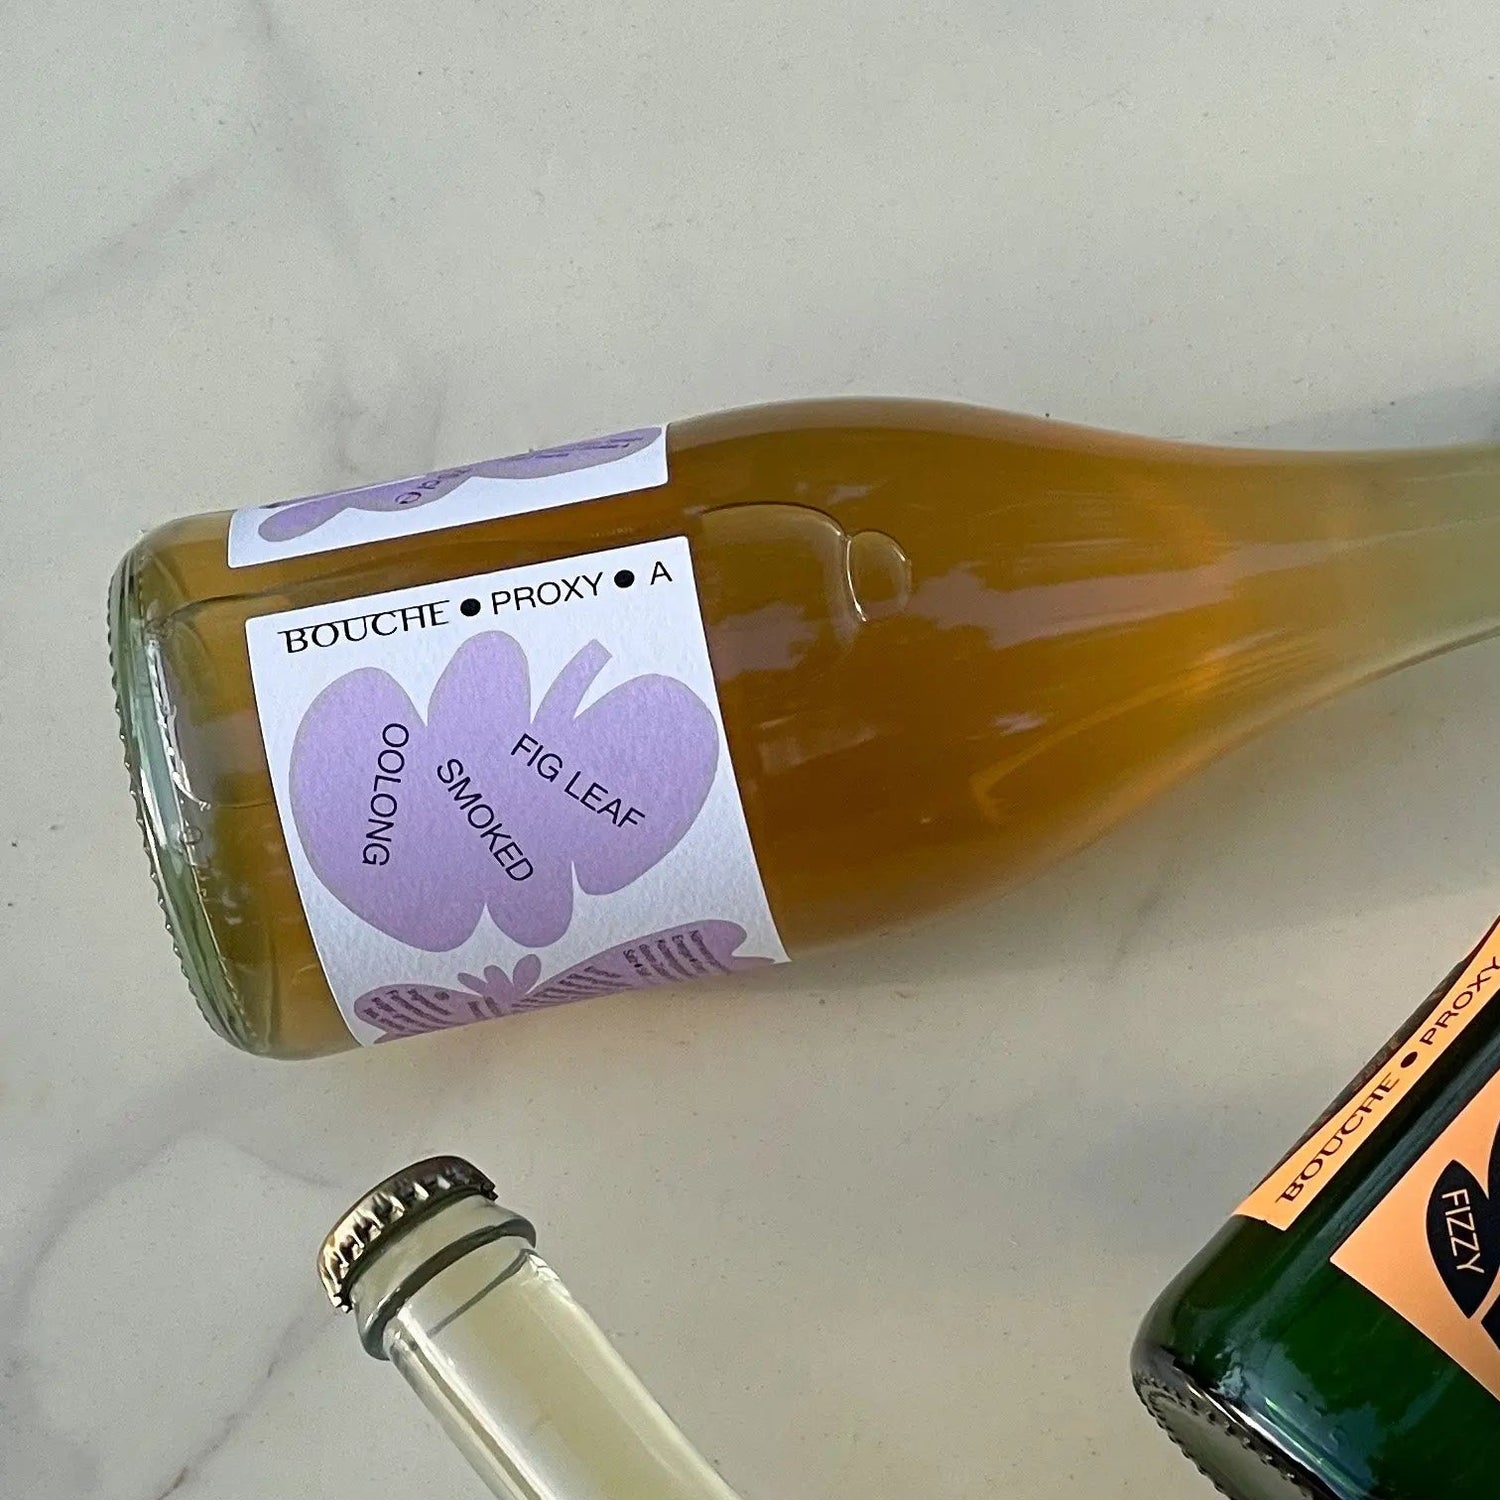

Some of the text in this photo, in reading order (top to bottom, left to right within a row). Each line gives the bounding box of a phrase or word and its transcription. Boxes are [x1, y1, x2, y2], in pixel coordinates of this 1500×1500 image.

[278, 561, 672, 653] BOUCHE PROXY A
[362, 723, 409, 865] OOLONG
[437, 759, 533, 881] SMOKED
[511, 733, 645, 827] FIG LEAF
[1276, 1073, 1399, 1202] BOUCHE
[1419, 956, 1500, 1045] PROXY
[1442, 1189, 1484, 1273] FIZZY
